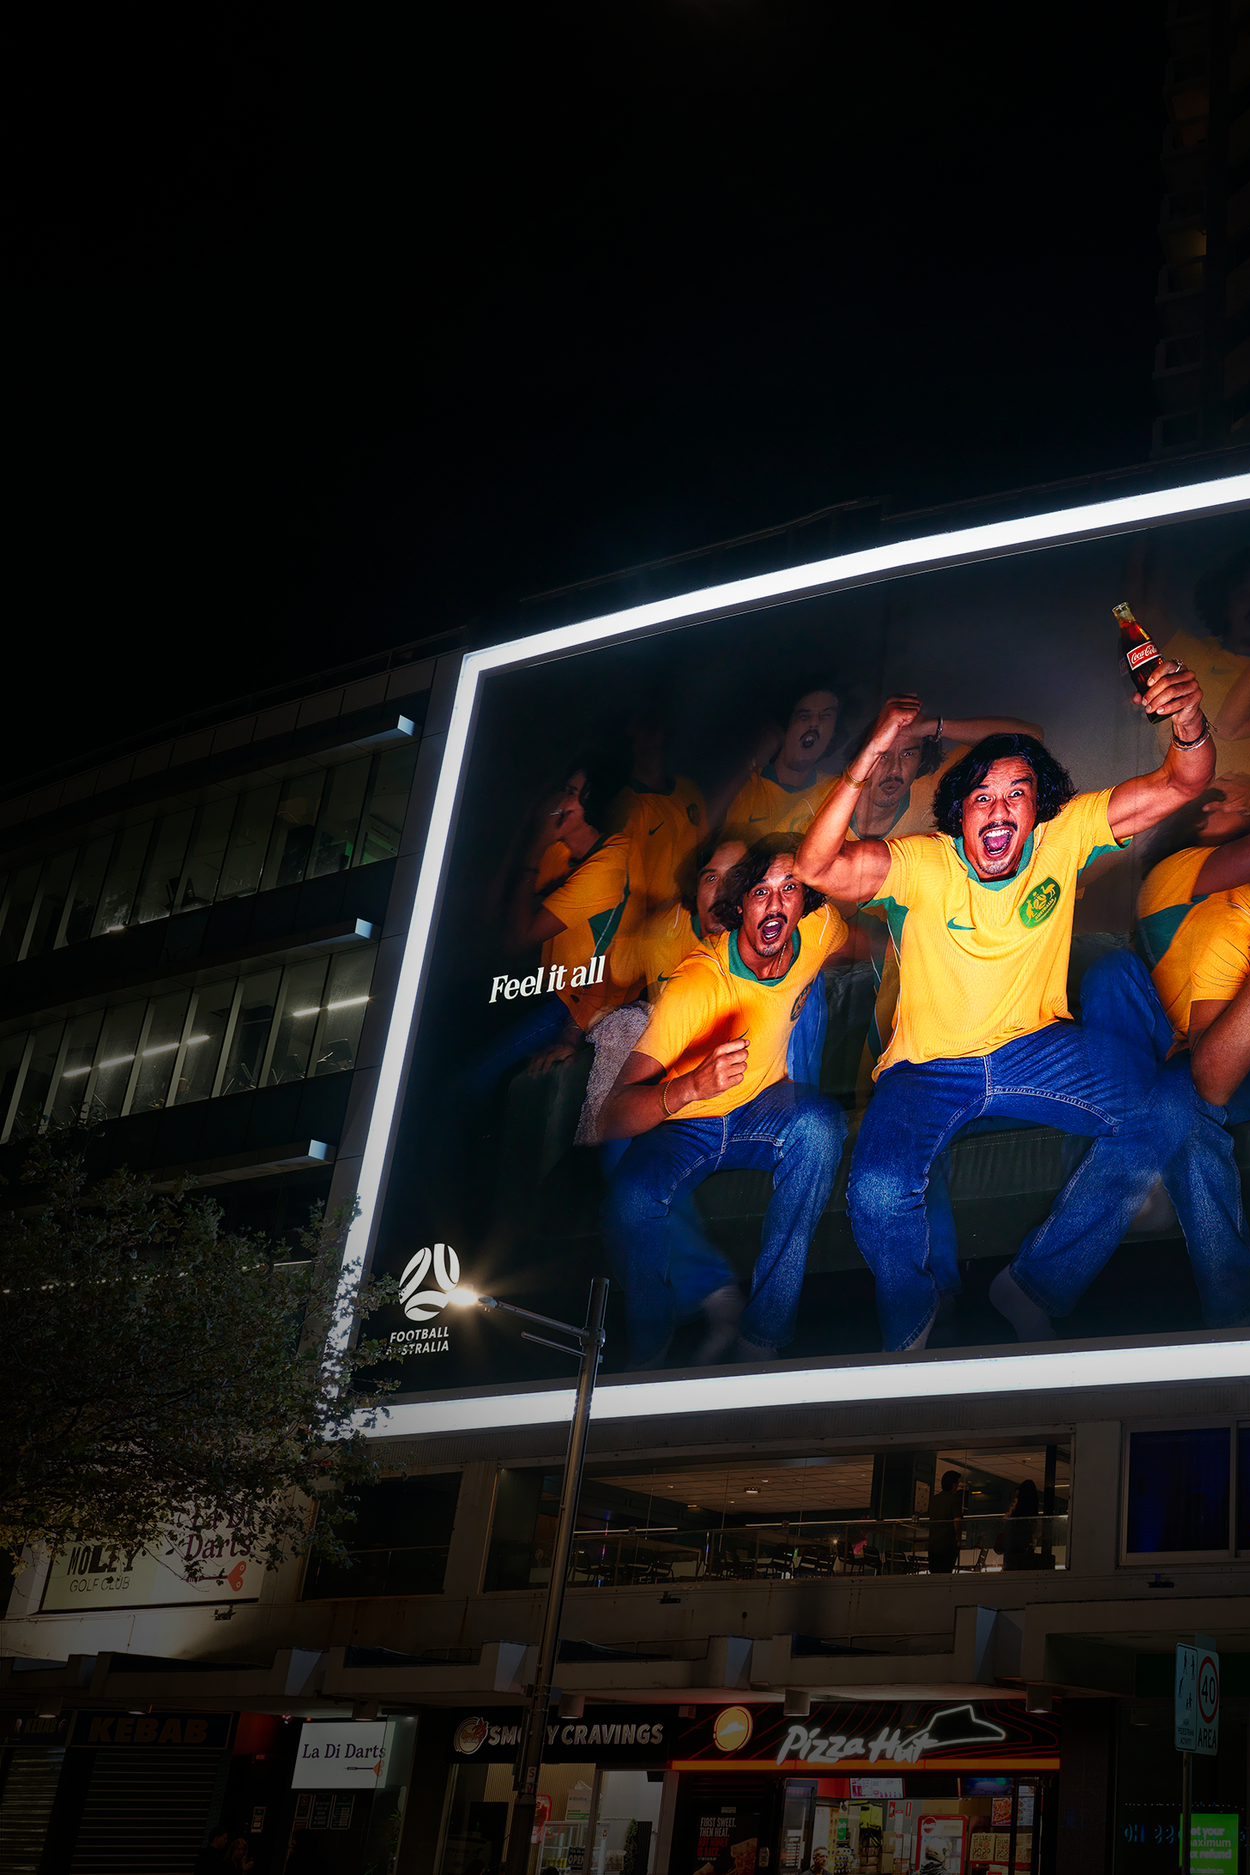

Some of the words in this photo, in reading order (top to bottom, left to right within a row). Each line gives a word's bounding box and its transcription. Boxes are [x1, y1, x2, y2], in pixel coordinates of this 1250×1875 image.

[488, 966, 545, 1004] Feel
[546, 964, 568, 993] it
[570, 955, 606, 988] all
[390, 1326, 450, 1343] FOOTBALL
[69, 1578, 100, 1593] GOLF
[101, 1576, 131, 1591] CLUB
[1201, 1675, 1216, 1705] 40
[23, 1717, 58, 1734] KEBAB
[87, 1717, 209, 1744] KEBAB
[488, 1725, 560, 1746] SMY
[561, 1723, 665, 1746] CRAVINGS
[1198, 1727, 1217, 1749] AREA
[302, 1744, 320, 1759] La
[324, 1744, 341, 1759] Di
[344, 1744, 386, 1759] Darts
[776, 1725, 865, 1766] Pizza
[867, 1727, 940, 1765] Hut
[700, 1817, 716, 1828] FIRST
[717, 1817, 737, 1828] SWEET.
[700, 1827, 714, 1837] THEN
[714, 1827, 730, 1837] HEAT.
[1191, 1826, 1201, 1836] et
[1202, 1827, 1225, 1840] your
[1191, 1839, 1232, 1847] aximum
[1199, 1848, 1232, 1859] refund
